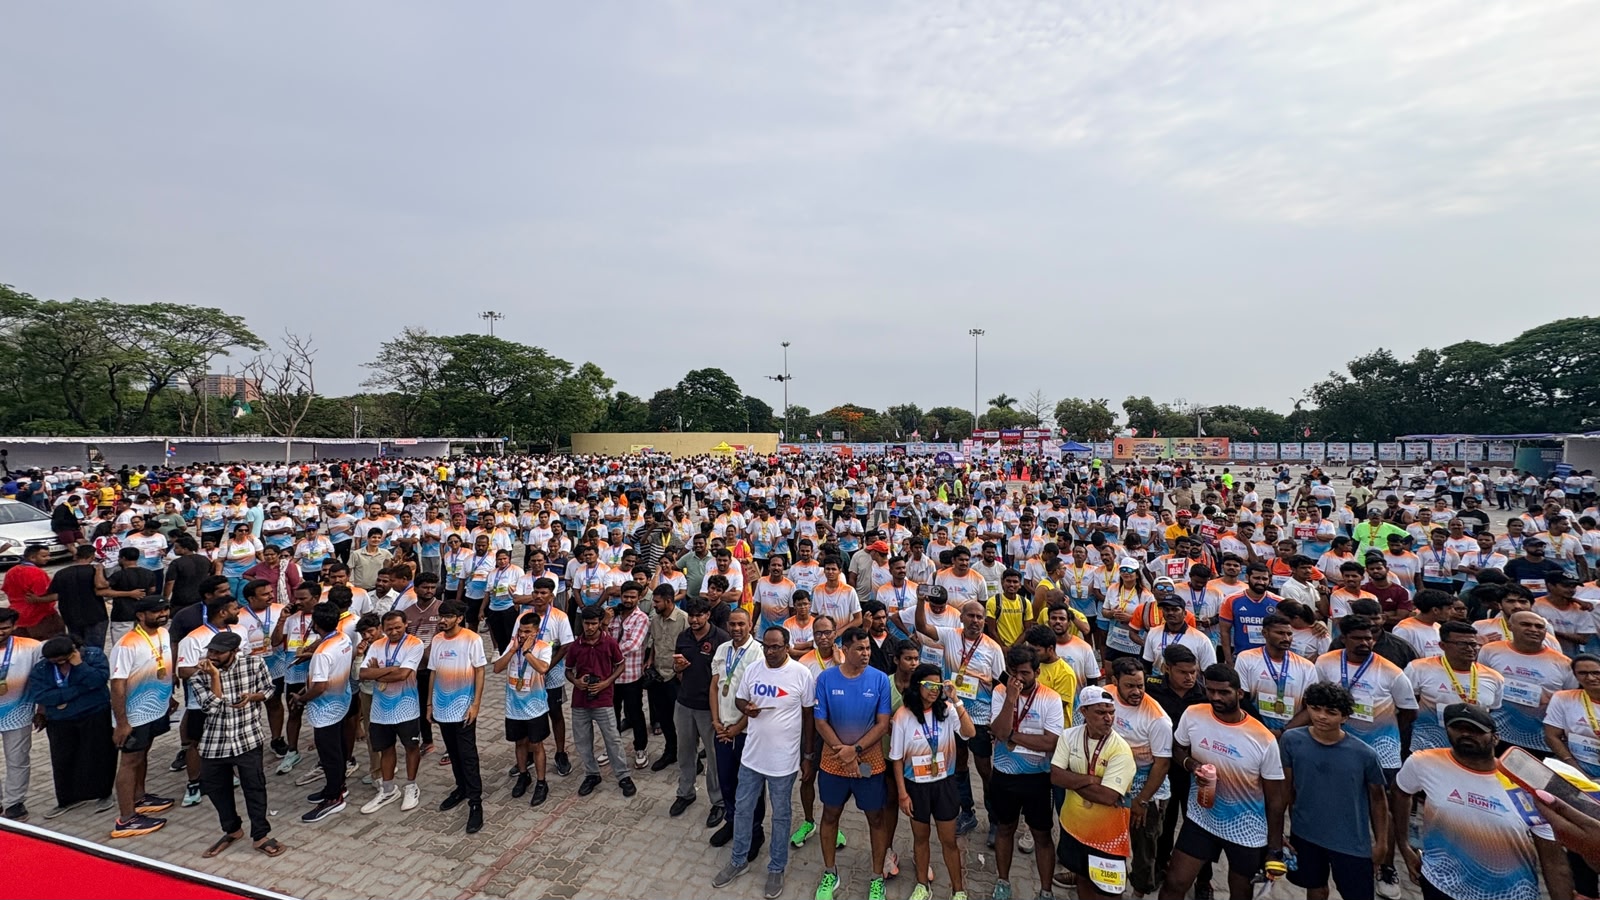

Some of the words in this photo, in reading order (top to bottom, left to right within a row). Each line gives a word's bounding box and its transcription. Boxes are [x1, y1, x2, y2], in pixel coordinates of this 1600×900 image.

[1117, 443, 1124, 453] 9
[1240, 616, 1264, 624] DREA
[753, 683, 777, 698] ION
[1100, 869, 1118, 879] 21680
